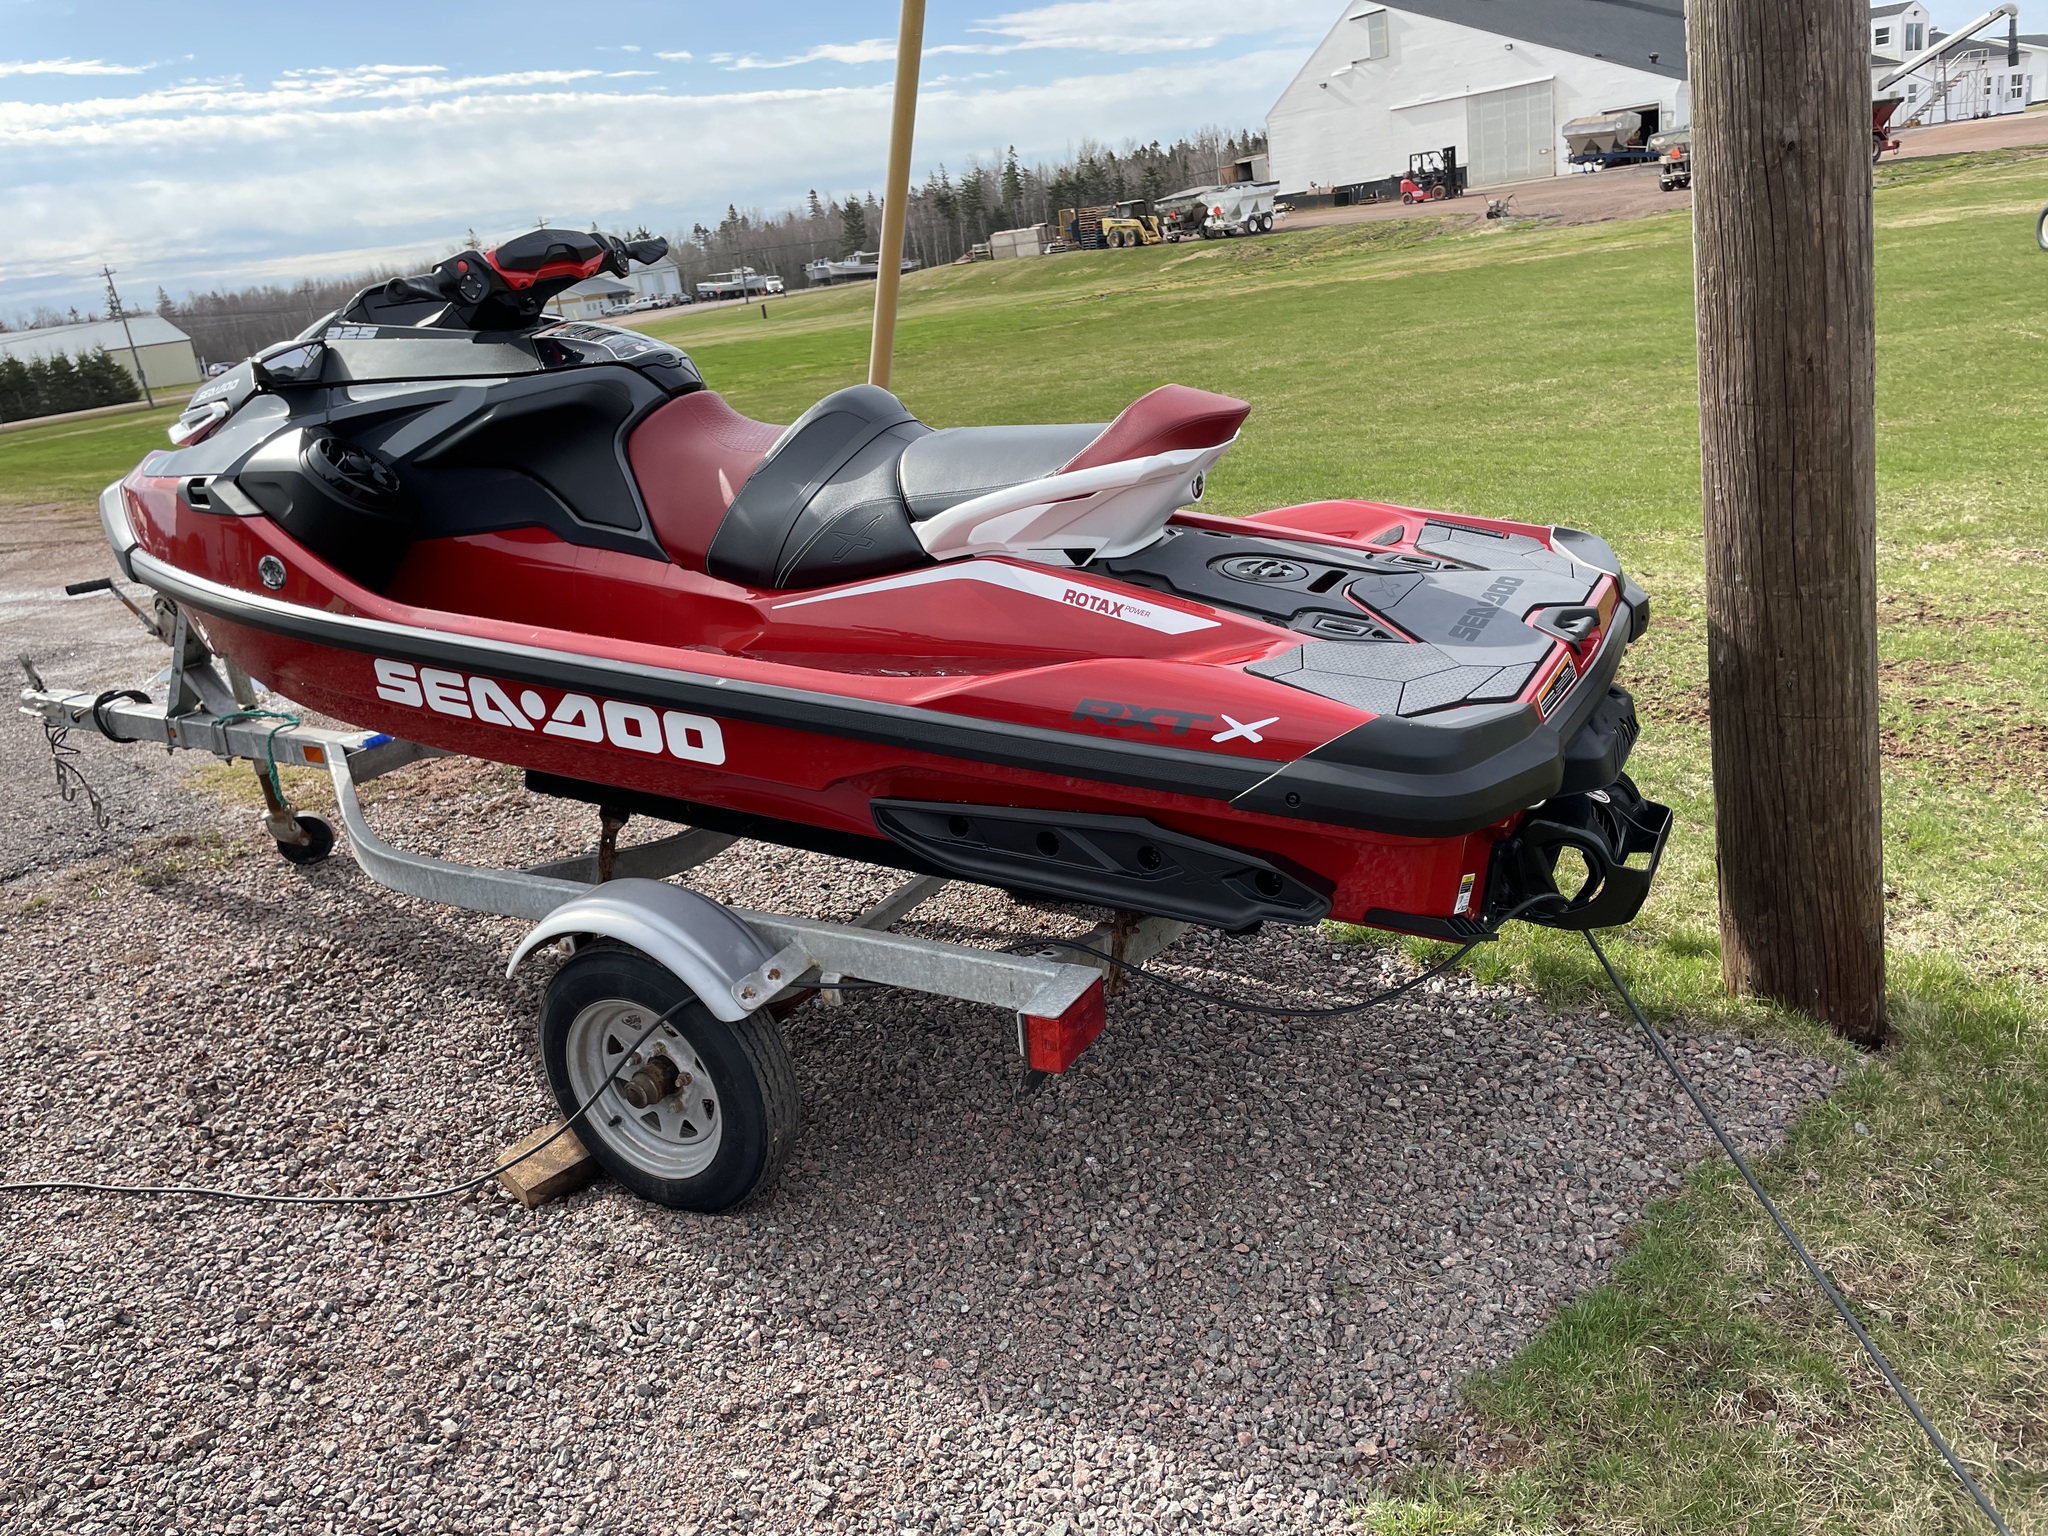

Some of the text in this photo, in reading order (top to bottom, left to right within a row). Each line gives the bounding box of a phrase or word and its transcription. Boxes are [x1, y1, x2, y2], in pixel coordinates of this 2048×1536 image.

[324, 326, 380, 339] 325
[1062, 588, 1151, 618] ROTAX POWER
[1070, 697, 1281, 744] RXT X
